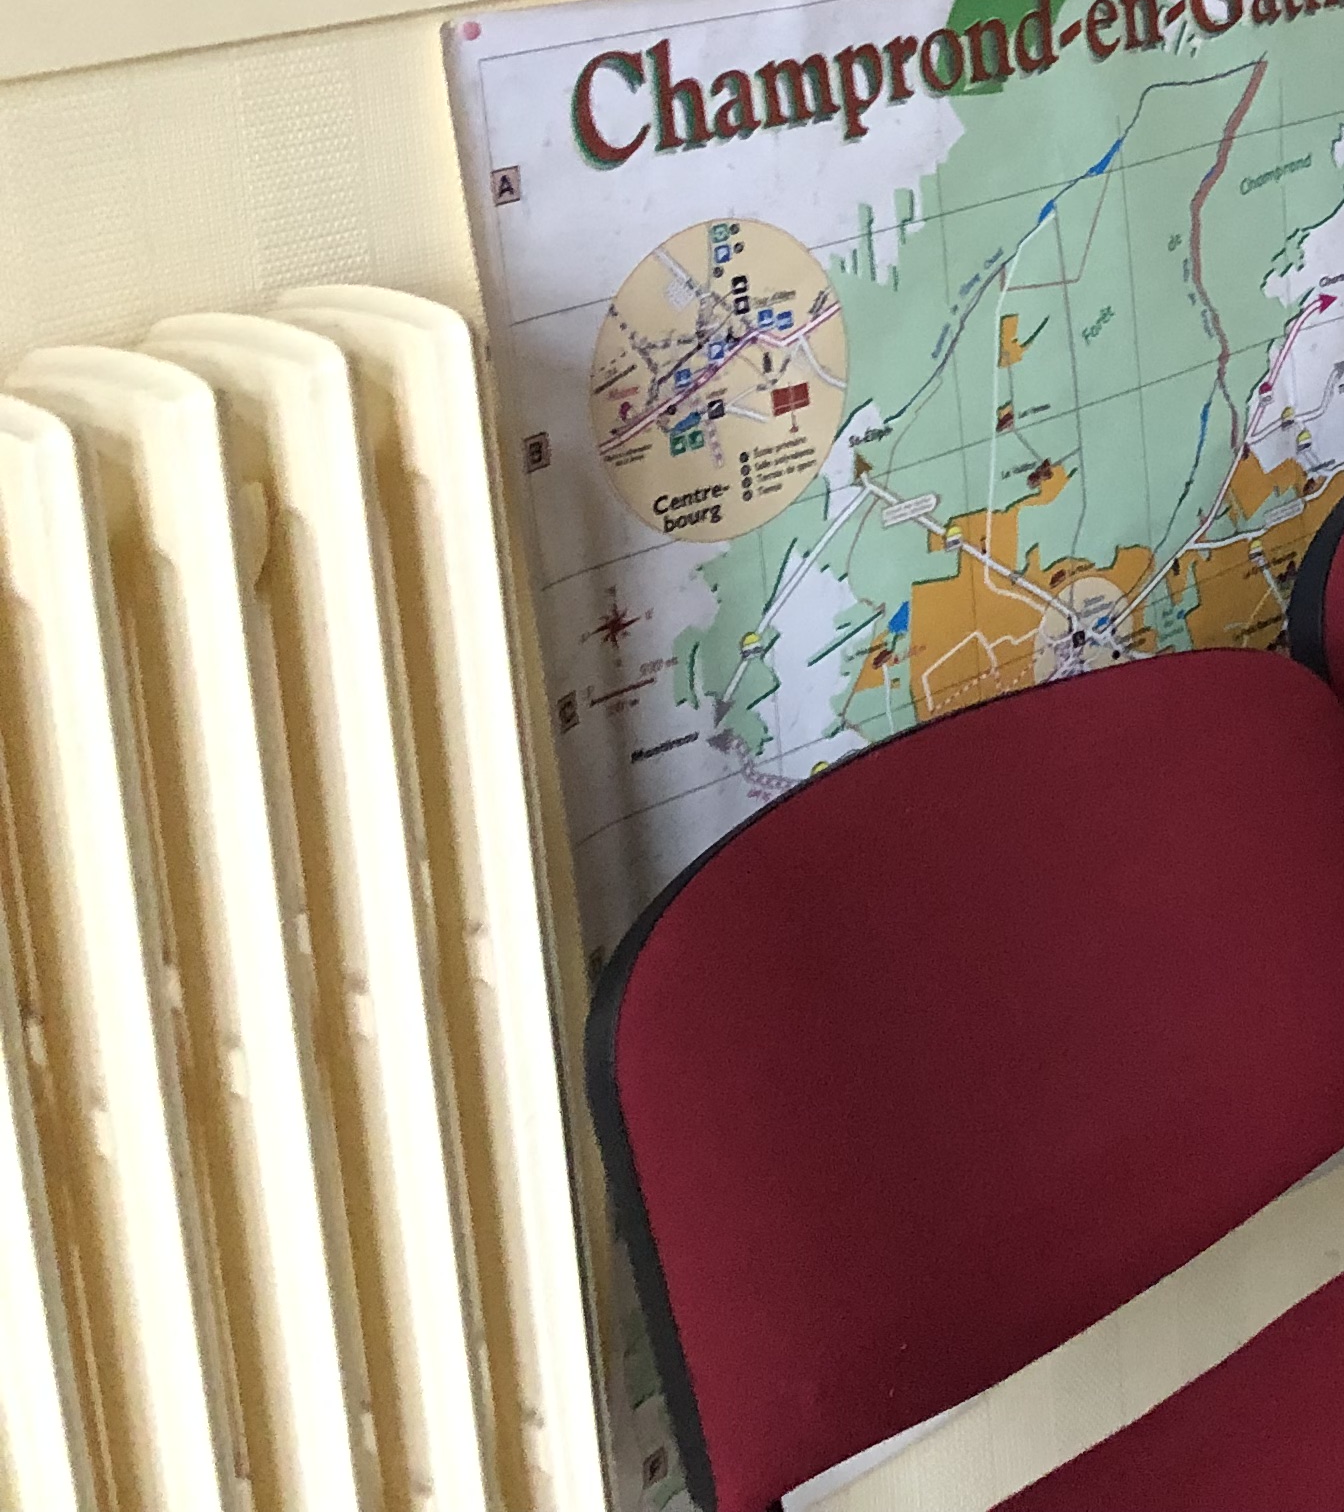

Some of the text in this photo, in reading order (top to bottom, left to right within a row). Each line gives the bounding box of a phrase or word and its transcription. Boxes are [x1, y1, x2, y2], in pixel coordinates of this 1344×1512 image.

[1240, 151, 1313, 196] Champrond
[653, 483, 730, 516] Centre-
[663, 503, 723, 534] bourg
